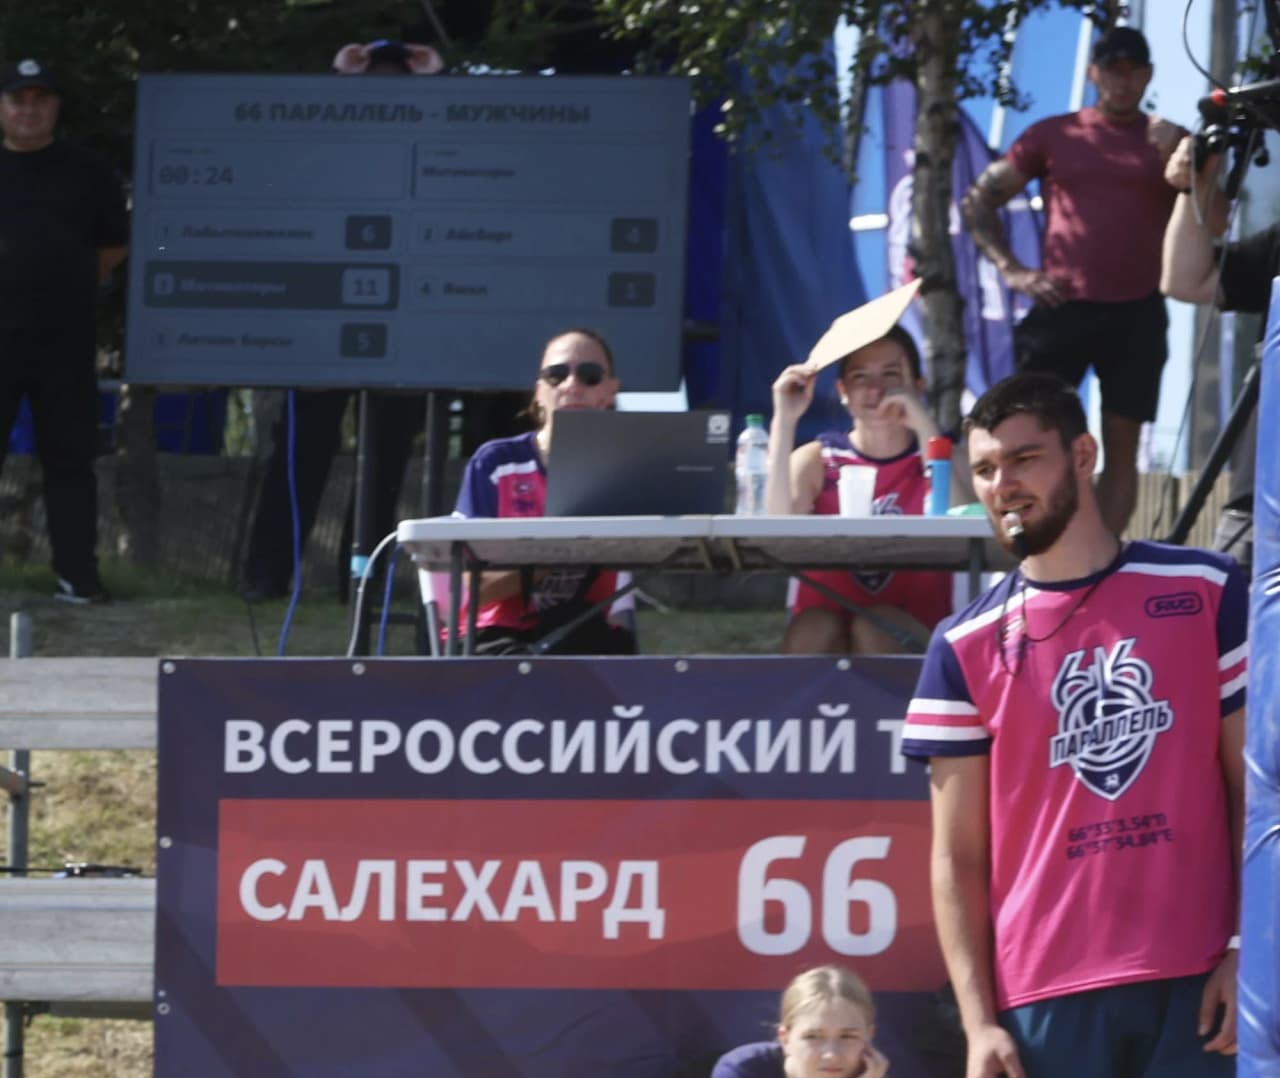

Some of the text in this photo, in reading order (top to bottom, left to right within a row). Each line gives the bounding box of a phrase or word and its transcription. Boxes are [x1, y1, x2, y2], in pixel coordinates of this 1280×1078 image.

[269, 103, 423, 125] ПАРАЛЛЕЛЬ
[446, 103, 591, 125] МУЖЧИНЫ
[353, 280, 379, 296] 11
[224, 704, 931, 775] ВСЕРОССИЙСКИЙ Т
[1052, 706, 1171, 763] ПАРАЛЛЕЛЬ
[239, 835, 898, 957] САЛЕХАРД 66
